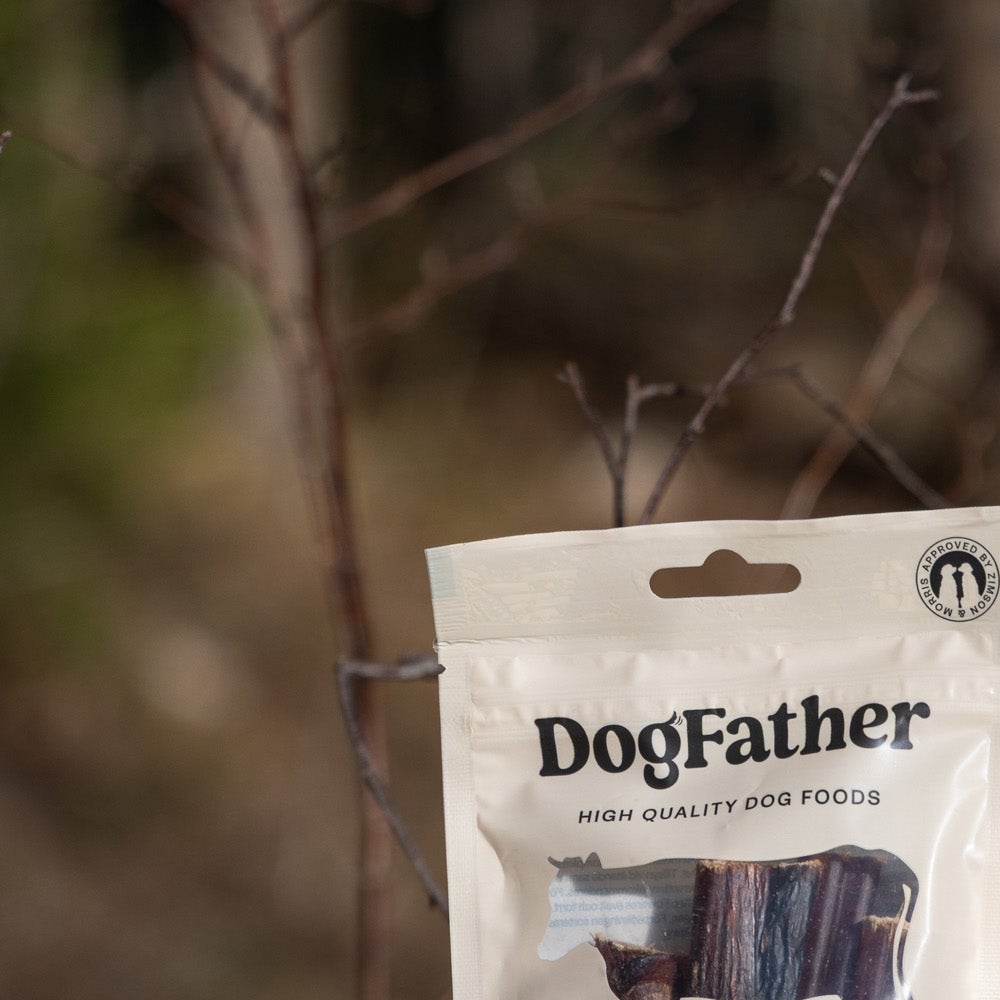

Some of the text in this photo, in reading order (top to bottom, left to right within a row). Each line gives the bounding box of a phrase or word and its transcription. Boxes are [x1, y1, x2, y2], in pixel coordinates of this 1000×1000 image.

[920, 541, 997, 618] APPROVED BY ZIMSON & MORRIS
[534, 694, 931, 790] DogFather
[578, 789, 882, 824] HIGH QUALITY DOG FOODS
